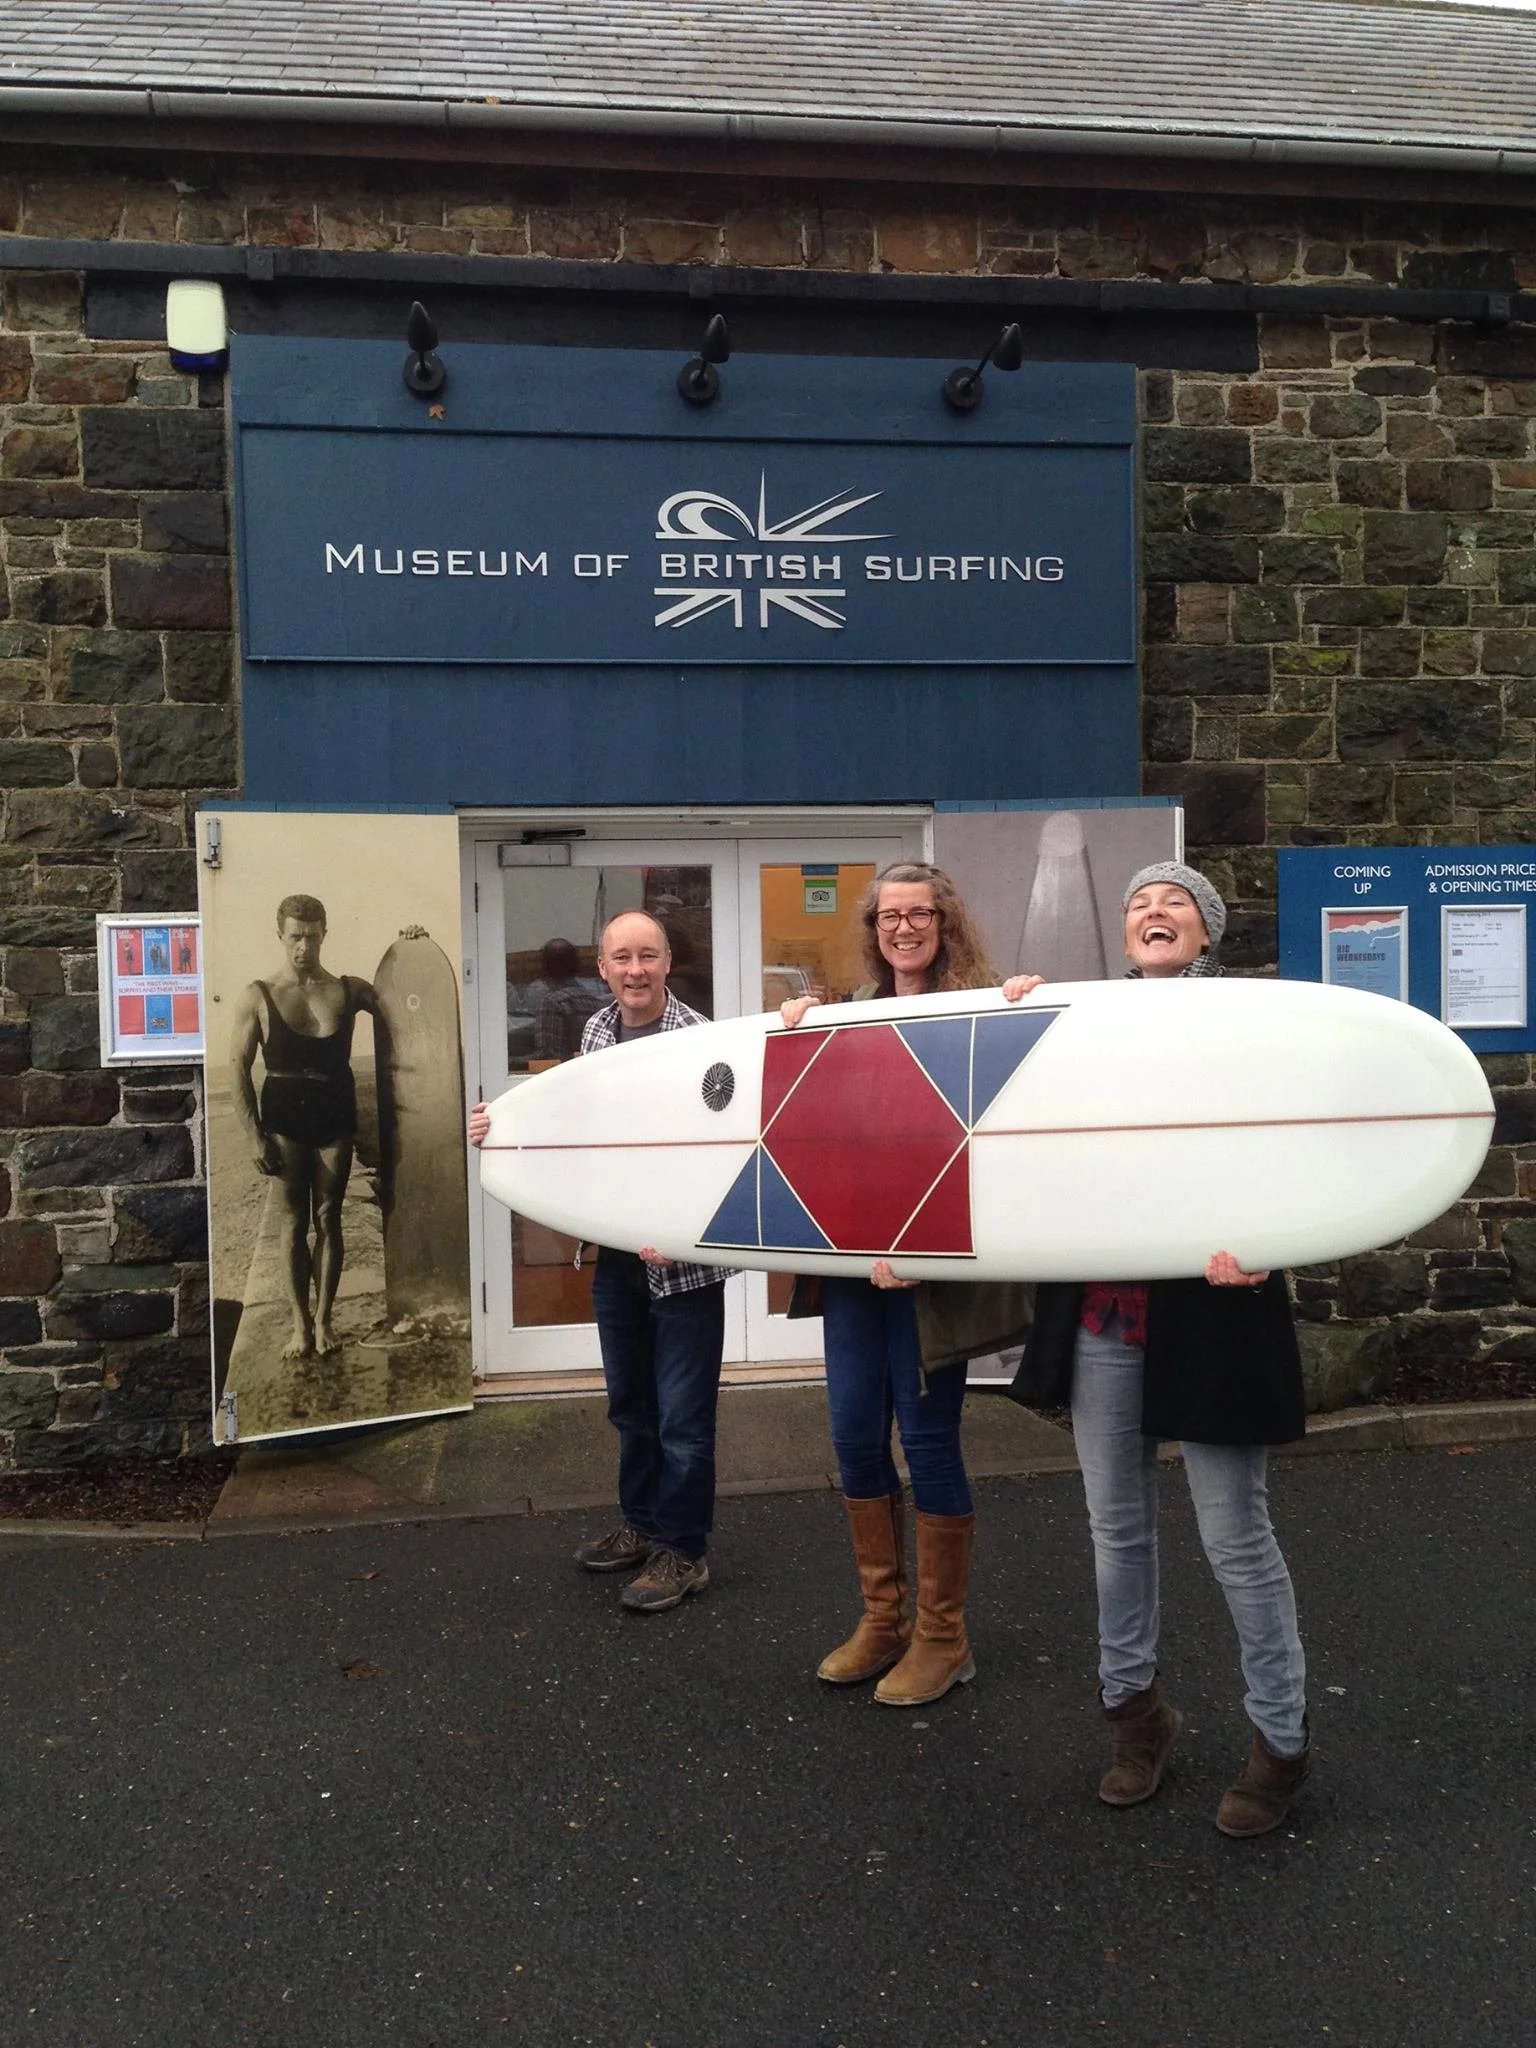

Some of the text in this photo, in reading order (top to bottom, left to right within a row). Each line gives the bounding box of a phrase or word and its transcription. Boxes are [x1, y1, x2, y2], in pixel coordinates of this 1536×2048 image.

[574, 553, 630, 578] OF
[660, 553, 841, 580] BRITISH
[864, 555, 1064, 582] SURFING
[1333, 865, 1391, 878] COMING
[1425, 864, 1497, 877] ADMISSION
[1354, 882, 1372, 895] UP
[1428, 881, 1438, 893] &
[1441, 880, 1502, 893] OPENING
